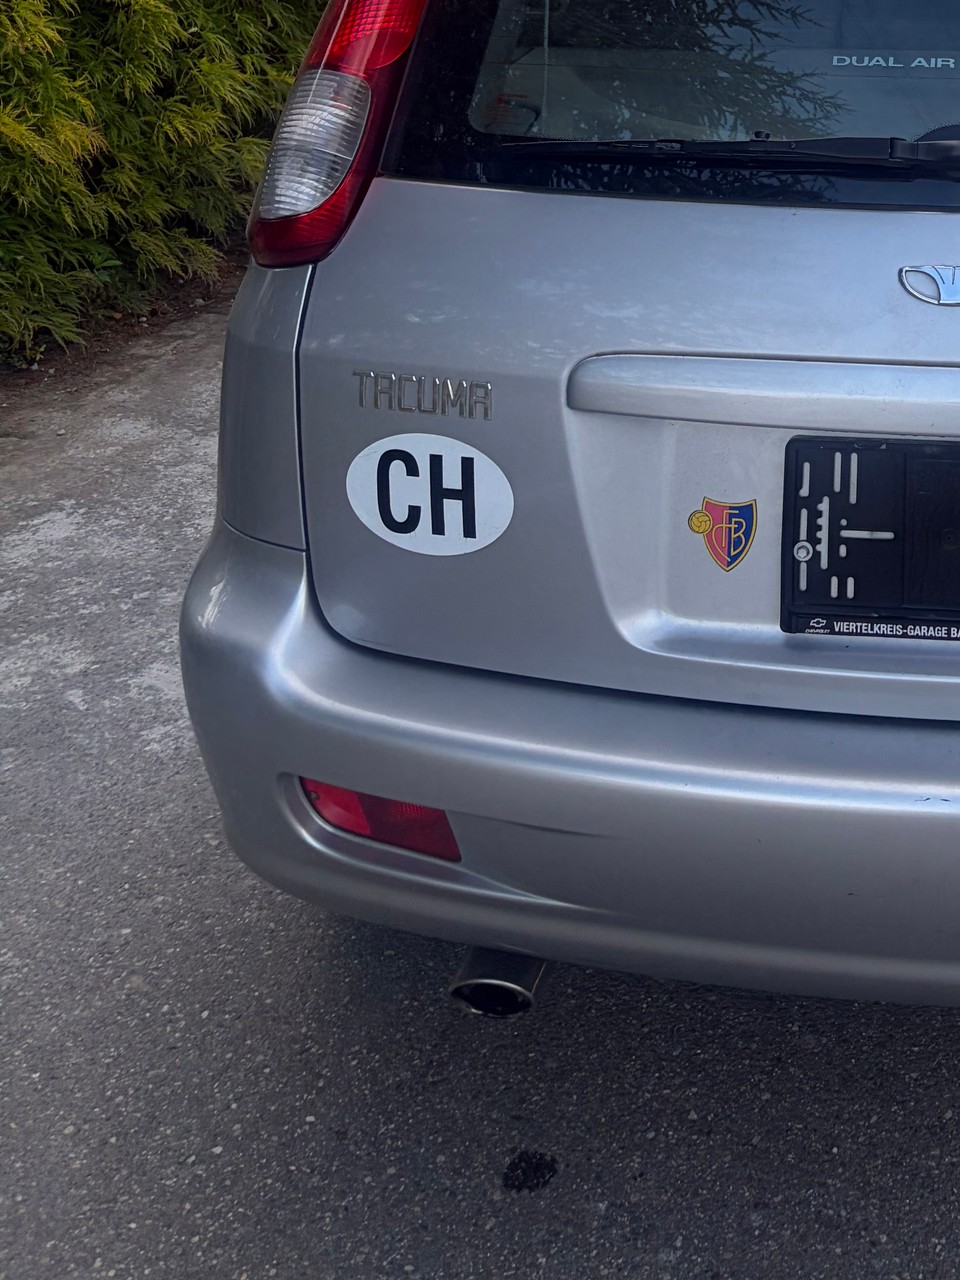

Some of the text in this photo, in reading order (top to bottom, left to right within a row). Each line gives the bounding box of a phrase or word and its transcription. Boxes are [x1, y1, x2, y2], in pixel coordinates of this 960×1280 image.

[832, 55, 904, 67] DUAL
[910, 57, 955, 69] AIR
[352, 370, 493, 421] TACUMA
[376, 448, 477, 539] CH
[833, 621, 948, 638] VIERTELKREIS-GARAGE
